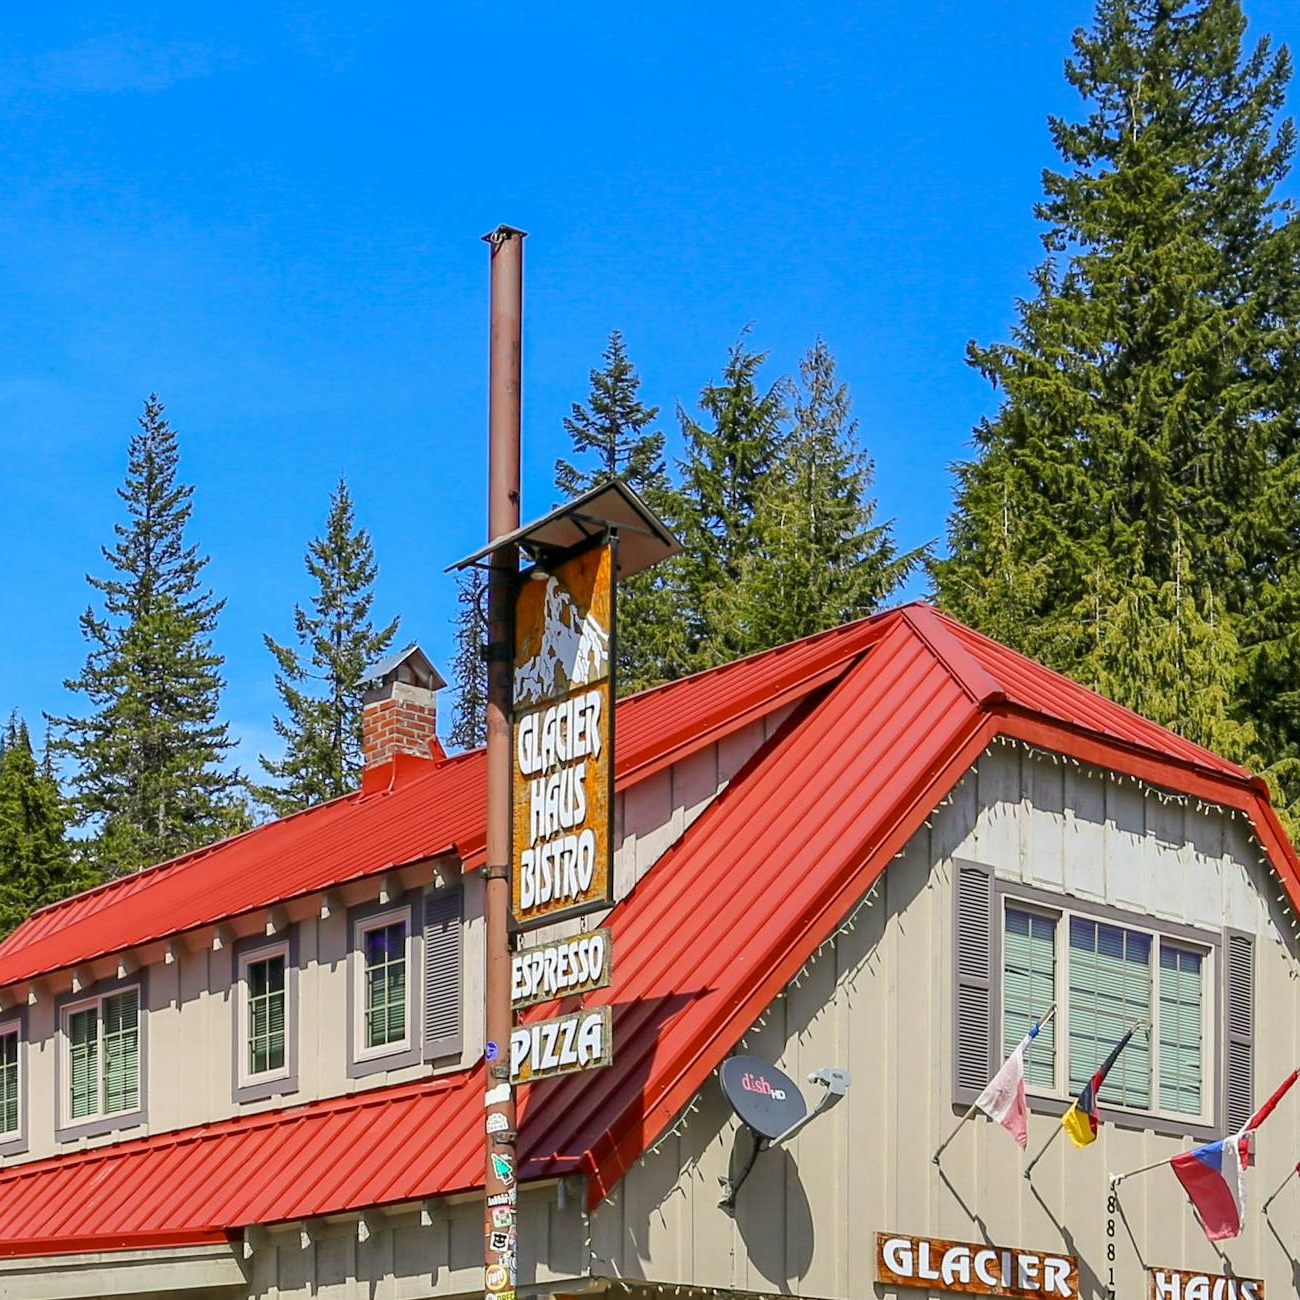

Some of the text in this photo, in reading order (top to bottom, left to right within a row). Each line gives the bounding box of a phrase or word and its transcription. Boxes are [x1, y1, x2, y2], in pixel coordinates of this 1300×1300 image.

[518, 690, 602, 776] GLACIER
[530, 763, 587, 840] HAUS
[520, 837, 595, 909] BISTRO
[511, 933, 604, 1001] ESPRESSO
[511, 1013, 602, 1075] PIZZA
[742, 1072, 786, 1100] dish HD
[882, 1238, 1073, 1299] GLACIER
